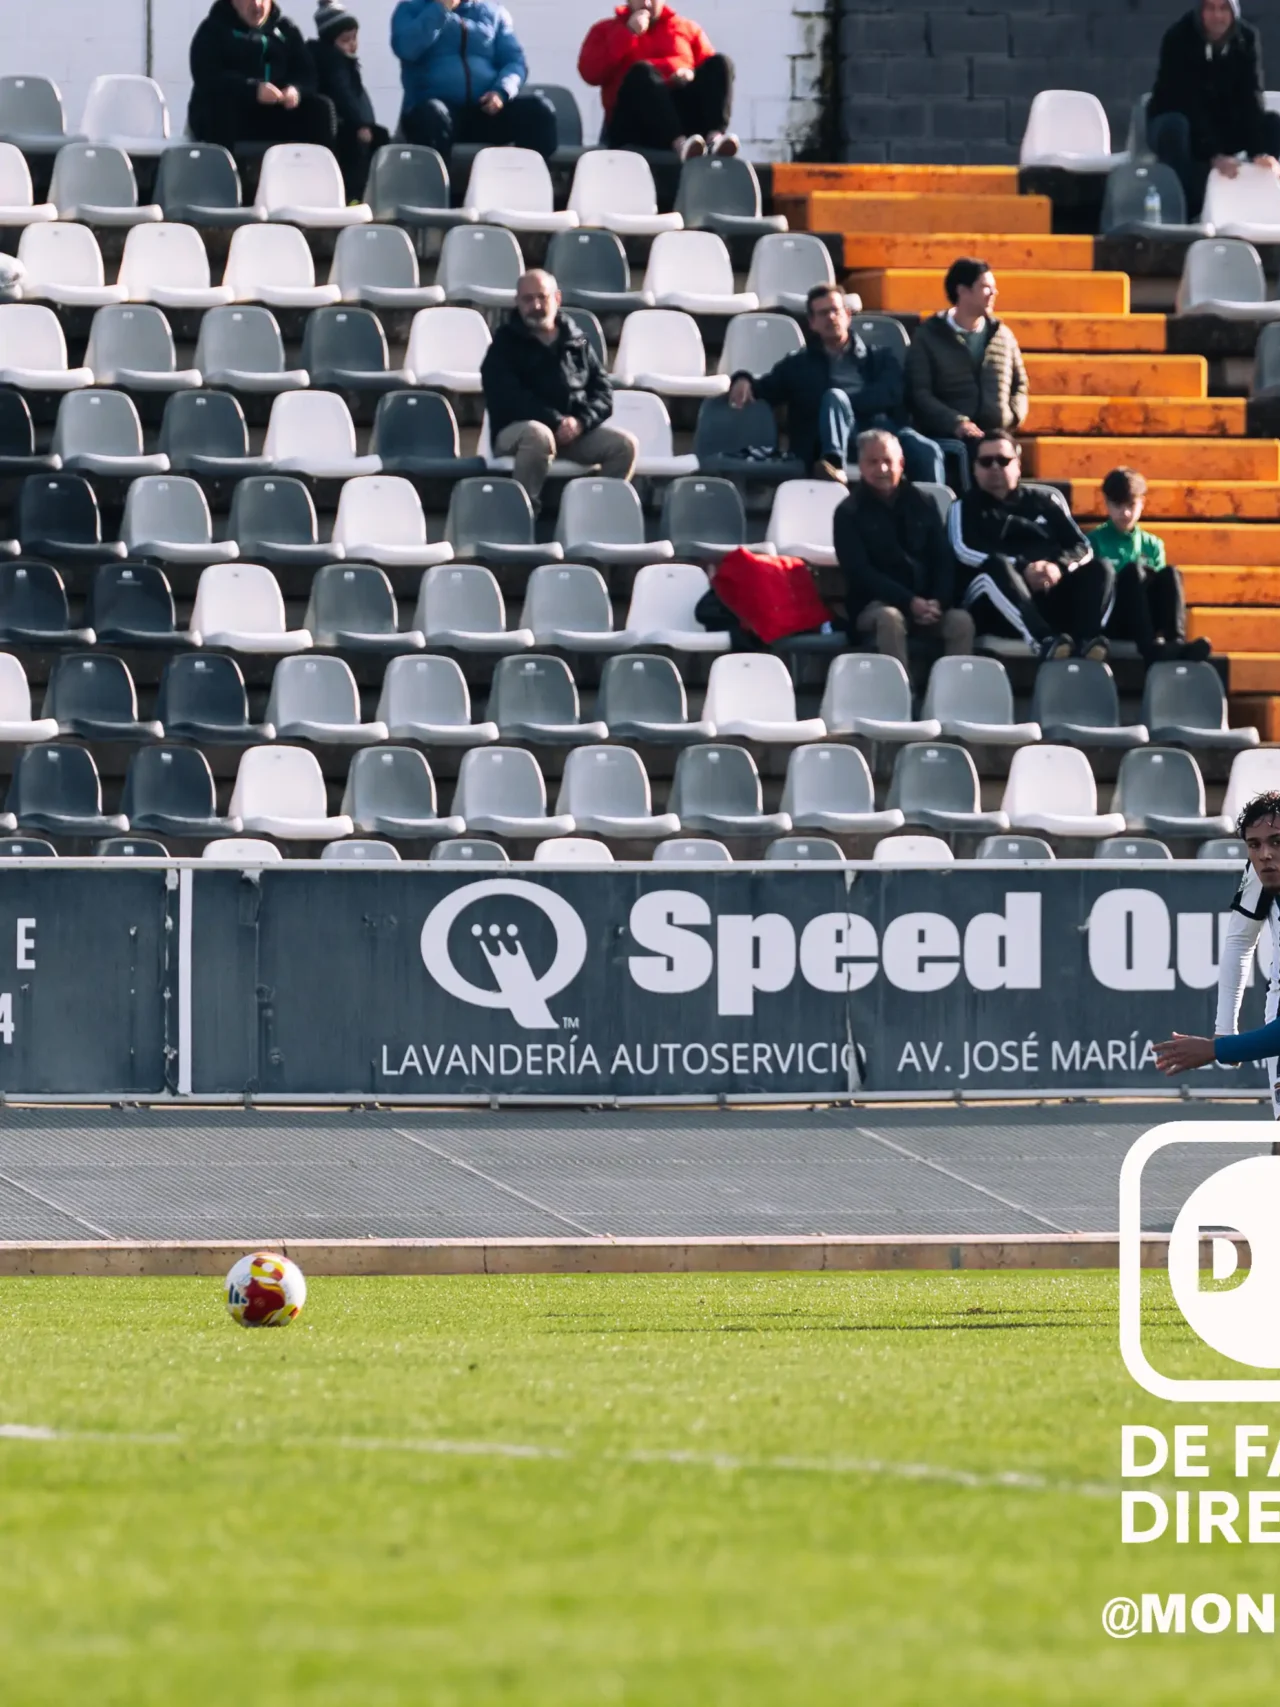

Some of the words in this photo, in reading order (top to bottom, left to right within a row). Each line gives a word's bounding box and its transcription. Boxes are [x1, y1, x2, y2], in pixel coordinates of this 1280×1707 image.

[17, 917, 36, 970] E
[628, 889, 1042, 1016] Speed
[562, 1016, 580, 1029] TM
[382, 1034, 601, 1076] LAVANDERÍA
[611, 1040, 867, 1075] AUTOSERVICIO
[898, 1040, 951, 1072] AV.
[959, 1031, 1039, 1079] JOSÉ
